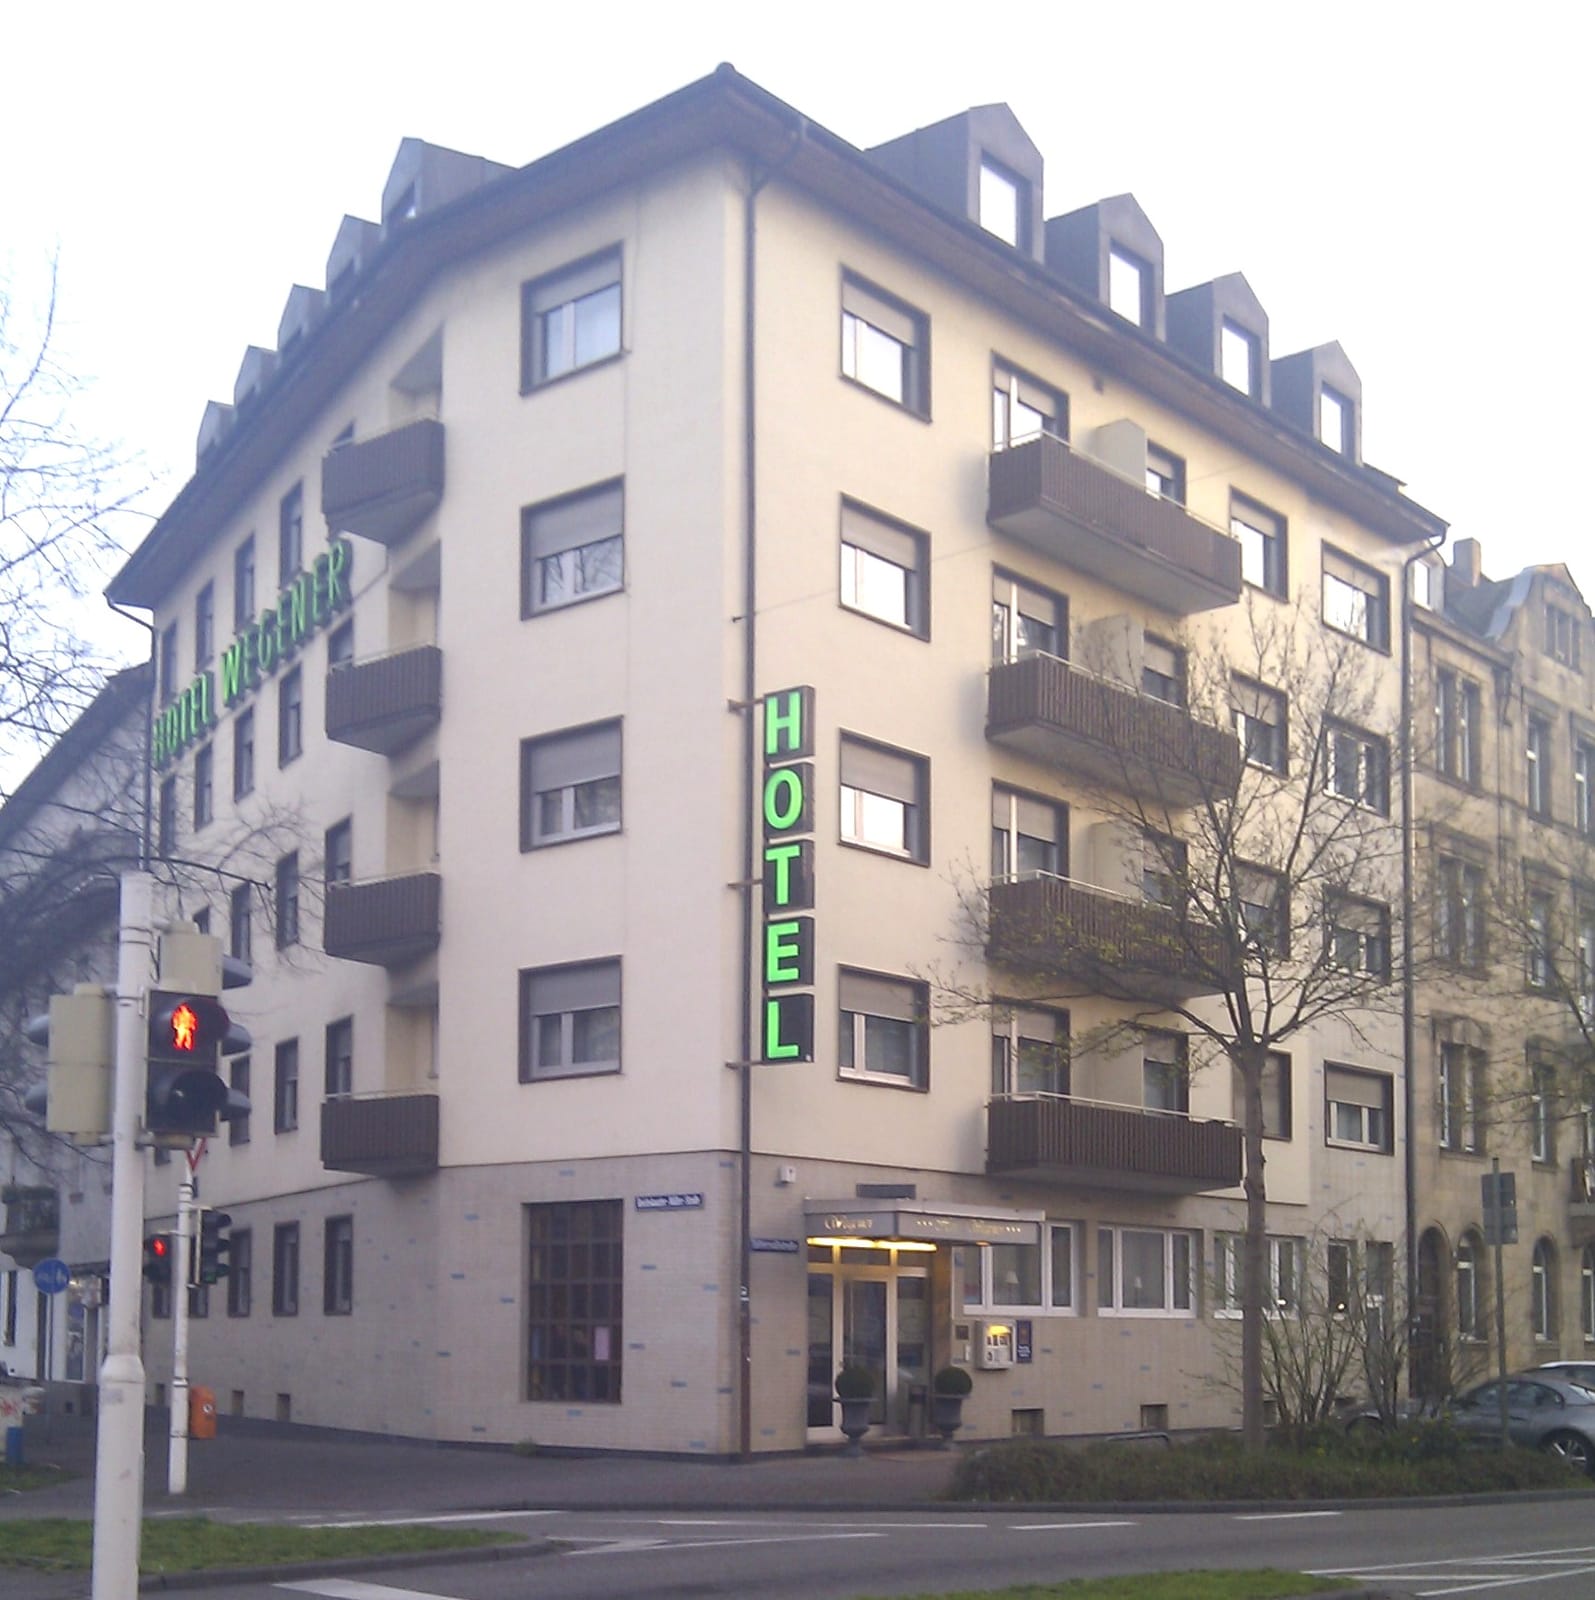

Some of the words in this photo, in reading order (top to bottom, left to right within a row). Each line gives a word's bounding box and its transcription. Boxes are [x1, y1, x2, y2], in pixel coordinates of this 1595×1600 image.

[153, 672, 210, 767] HOTEL
[221, 540, 346, 703] WEGENER
[764, 691, 803, 1059] HOTEL
